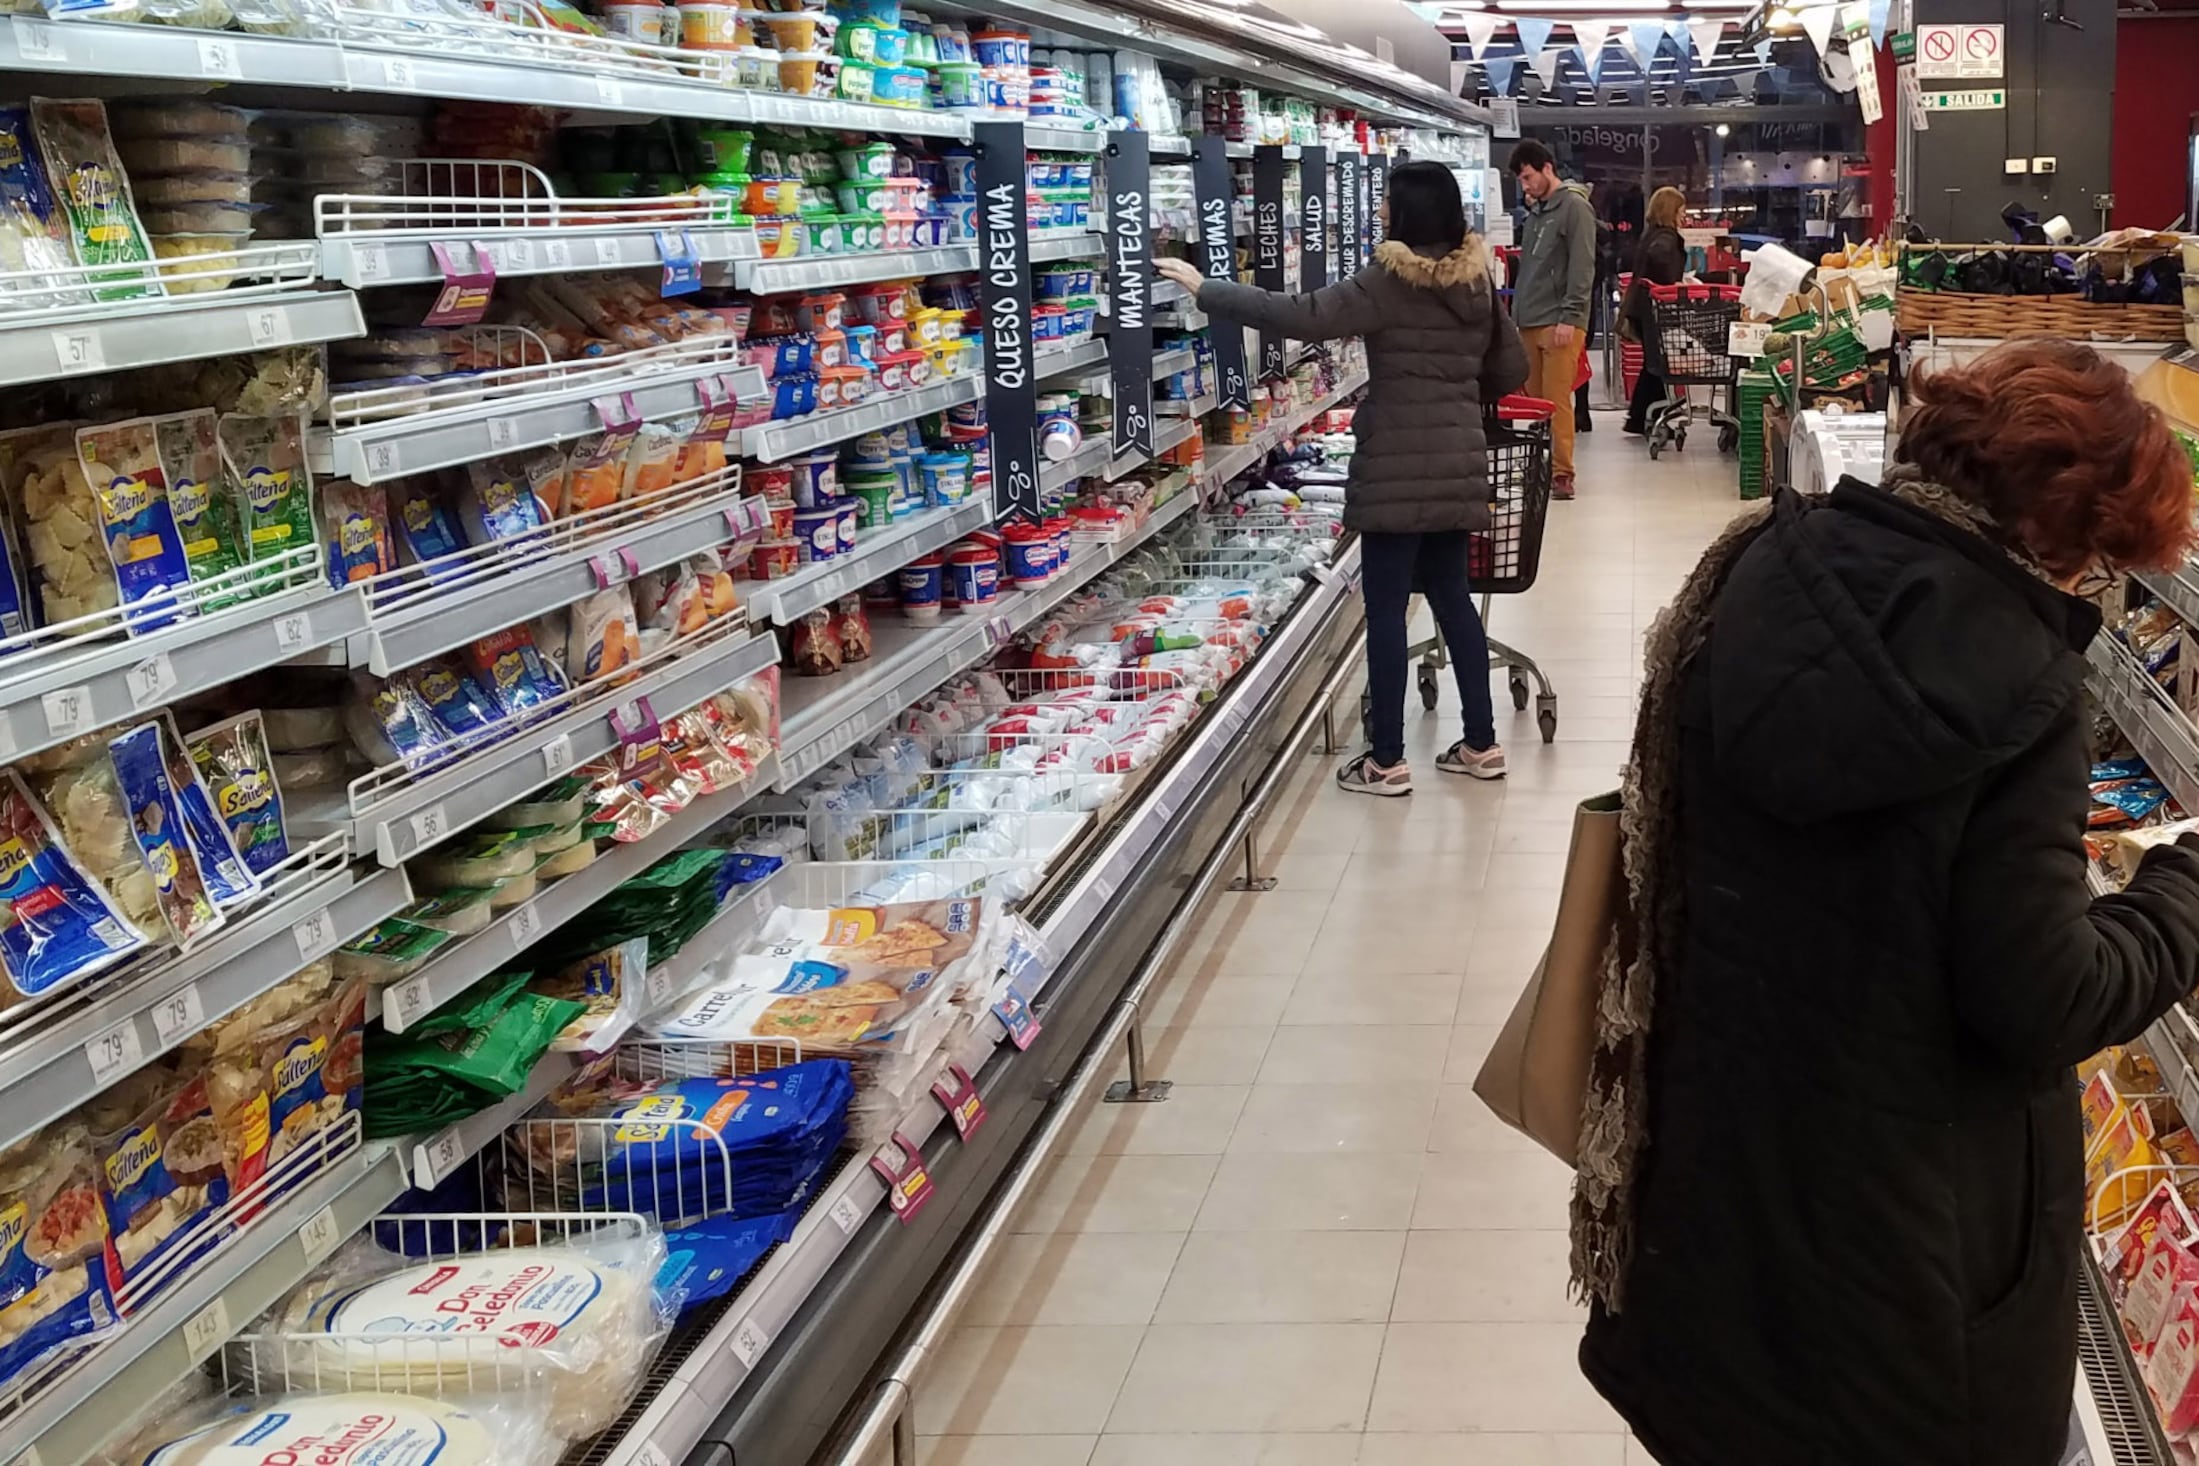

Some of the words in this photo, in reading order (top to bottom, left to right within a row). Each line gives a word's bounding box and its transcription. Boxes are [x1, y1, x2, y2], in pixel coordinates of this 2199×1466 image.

[1946, 93, 1994, 107] SALIDA
[1342, 161, 1355, 245] DESCREMADO
[1371, 167, 1383, 211] ENTERO
[986, 183, 1017, 288] CREMA
[1258, 201, 1279, 270] LECHES
[1305, 195, 1323, 252] SALUD
[1116, 191, 1145, 329] MANTECAS
[1342, 248, 1356, 282] OGUR
[992, 297, 1025, 389] QUESO
[249, 481, 288, 502] alteña
[139, 663, 159, 689] 79
[59, 696, 78, 722] 79
[167, 1000, 186, 1025] 79
[101, 1033, 122, 1062] 79
[278, 1047, 326, 1090] Salteña
[109, 1140, 158, 1187] Salteña
[436, 1284, 492, 1313] Don
